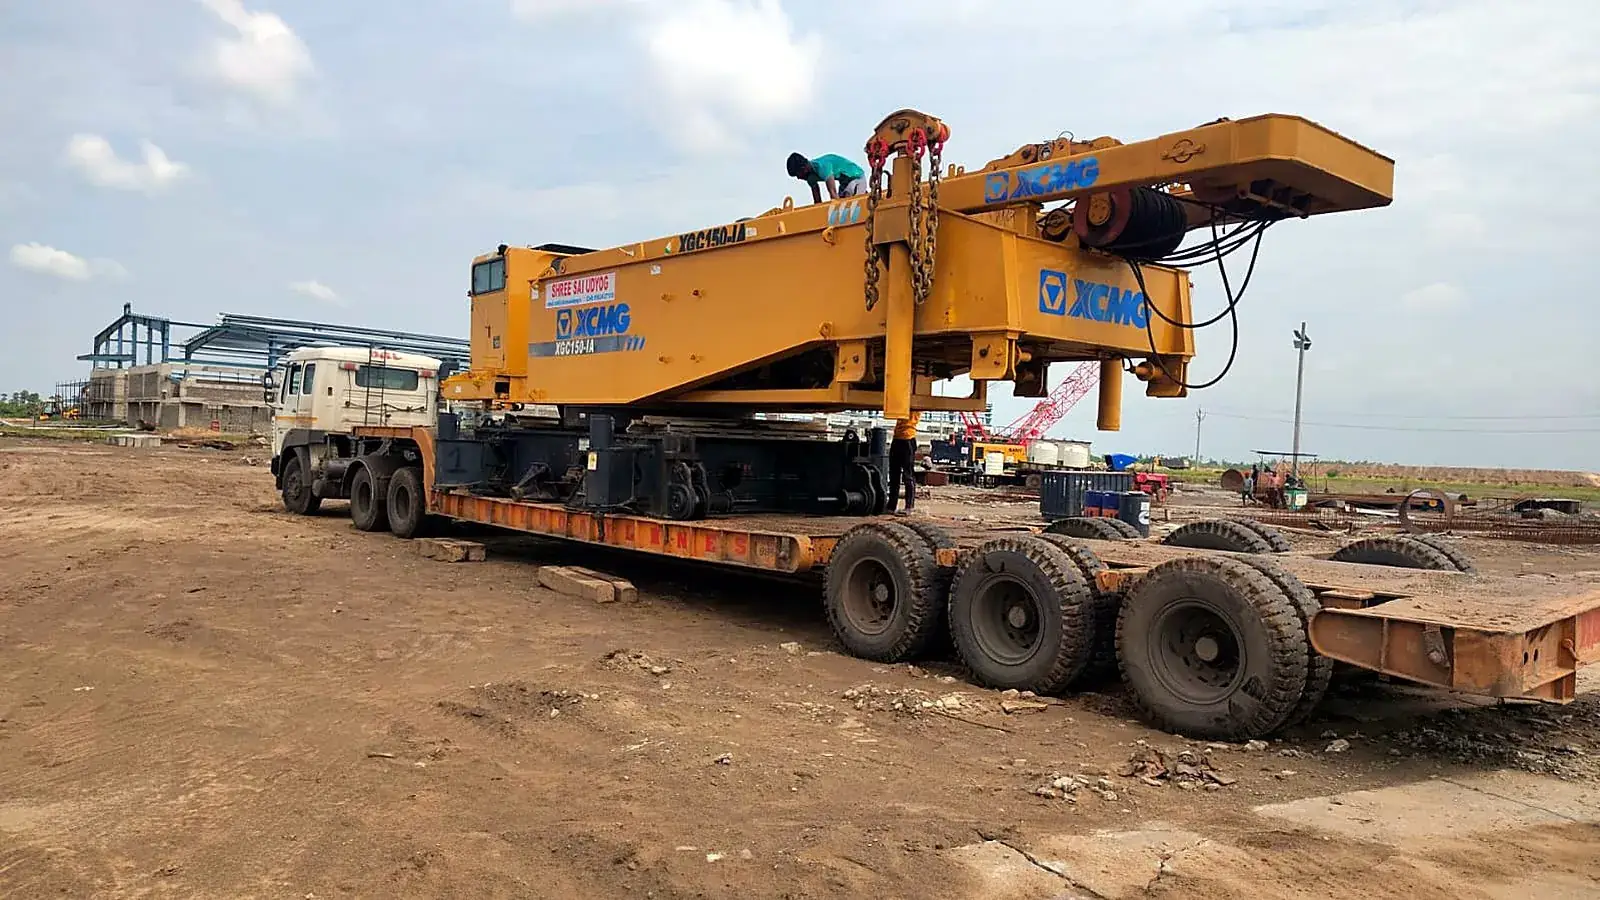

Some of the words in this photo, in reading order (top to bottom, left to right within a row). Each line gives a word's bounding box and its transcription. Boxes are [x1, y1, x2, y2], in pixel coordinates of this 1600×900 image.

[1010, 156, 1100, 199] XCMG
[678, 224, 746, 253] XGC150-IA
[551, 281, 572, 298] SHREE
[573, 279, 584, 295] SAI
[585, 275, 609, 293] UDYOG
[1067, 279, 1153, 329] XCMG
[574, 303, 631, 337] XCMG
[554, 338, 594, 356] XGC150-IA
